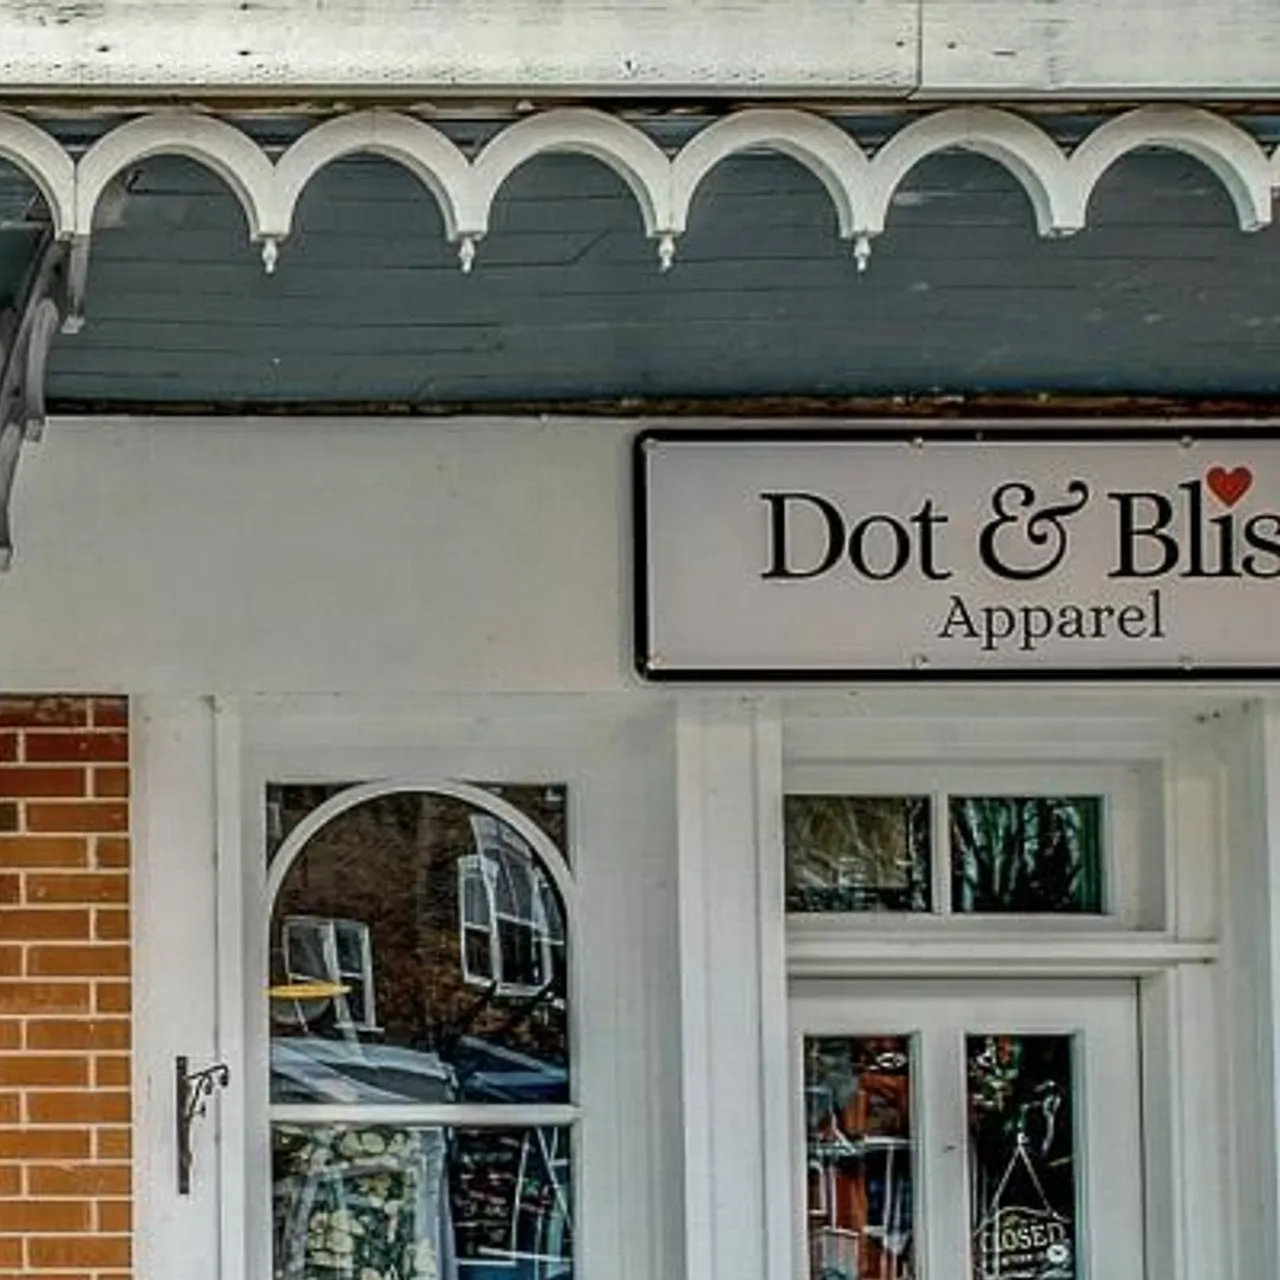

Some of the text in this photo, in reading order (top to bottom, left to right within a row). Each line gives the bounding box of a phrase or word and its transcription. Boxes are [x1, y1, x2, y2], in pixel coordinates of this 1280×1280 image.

[760, 492, 952, 581] Dot
[978, 480, 1089, 582] &
[939, 589, 1166, 650] Apparel
